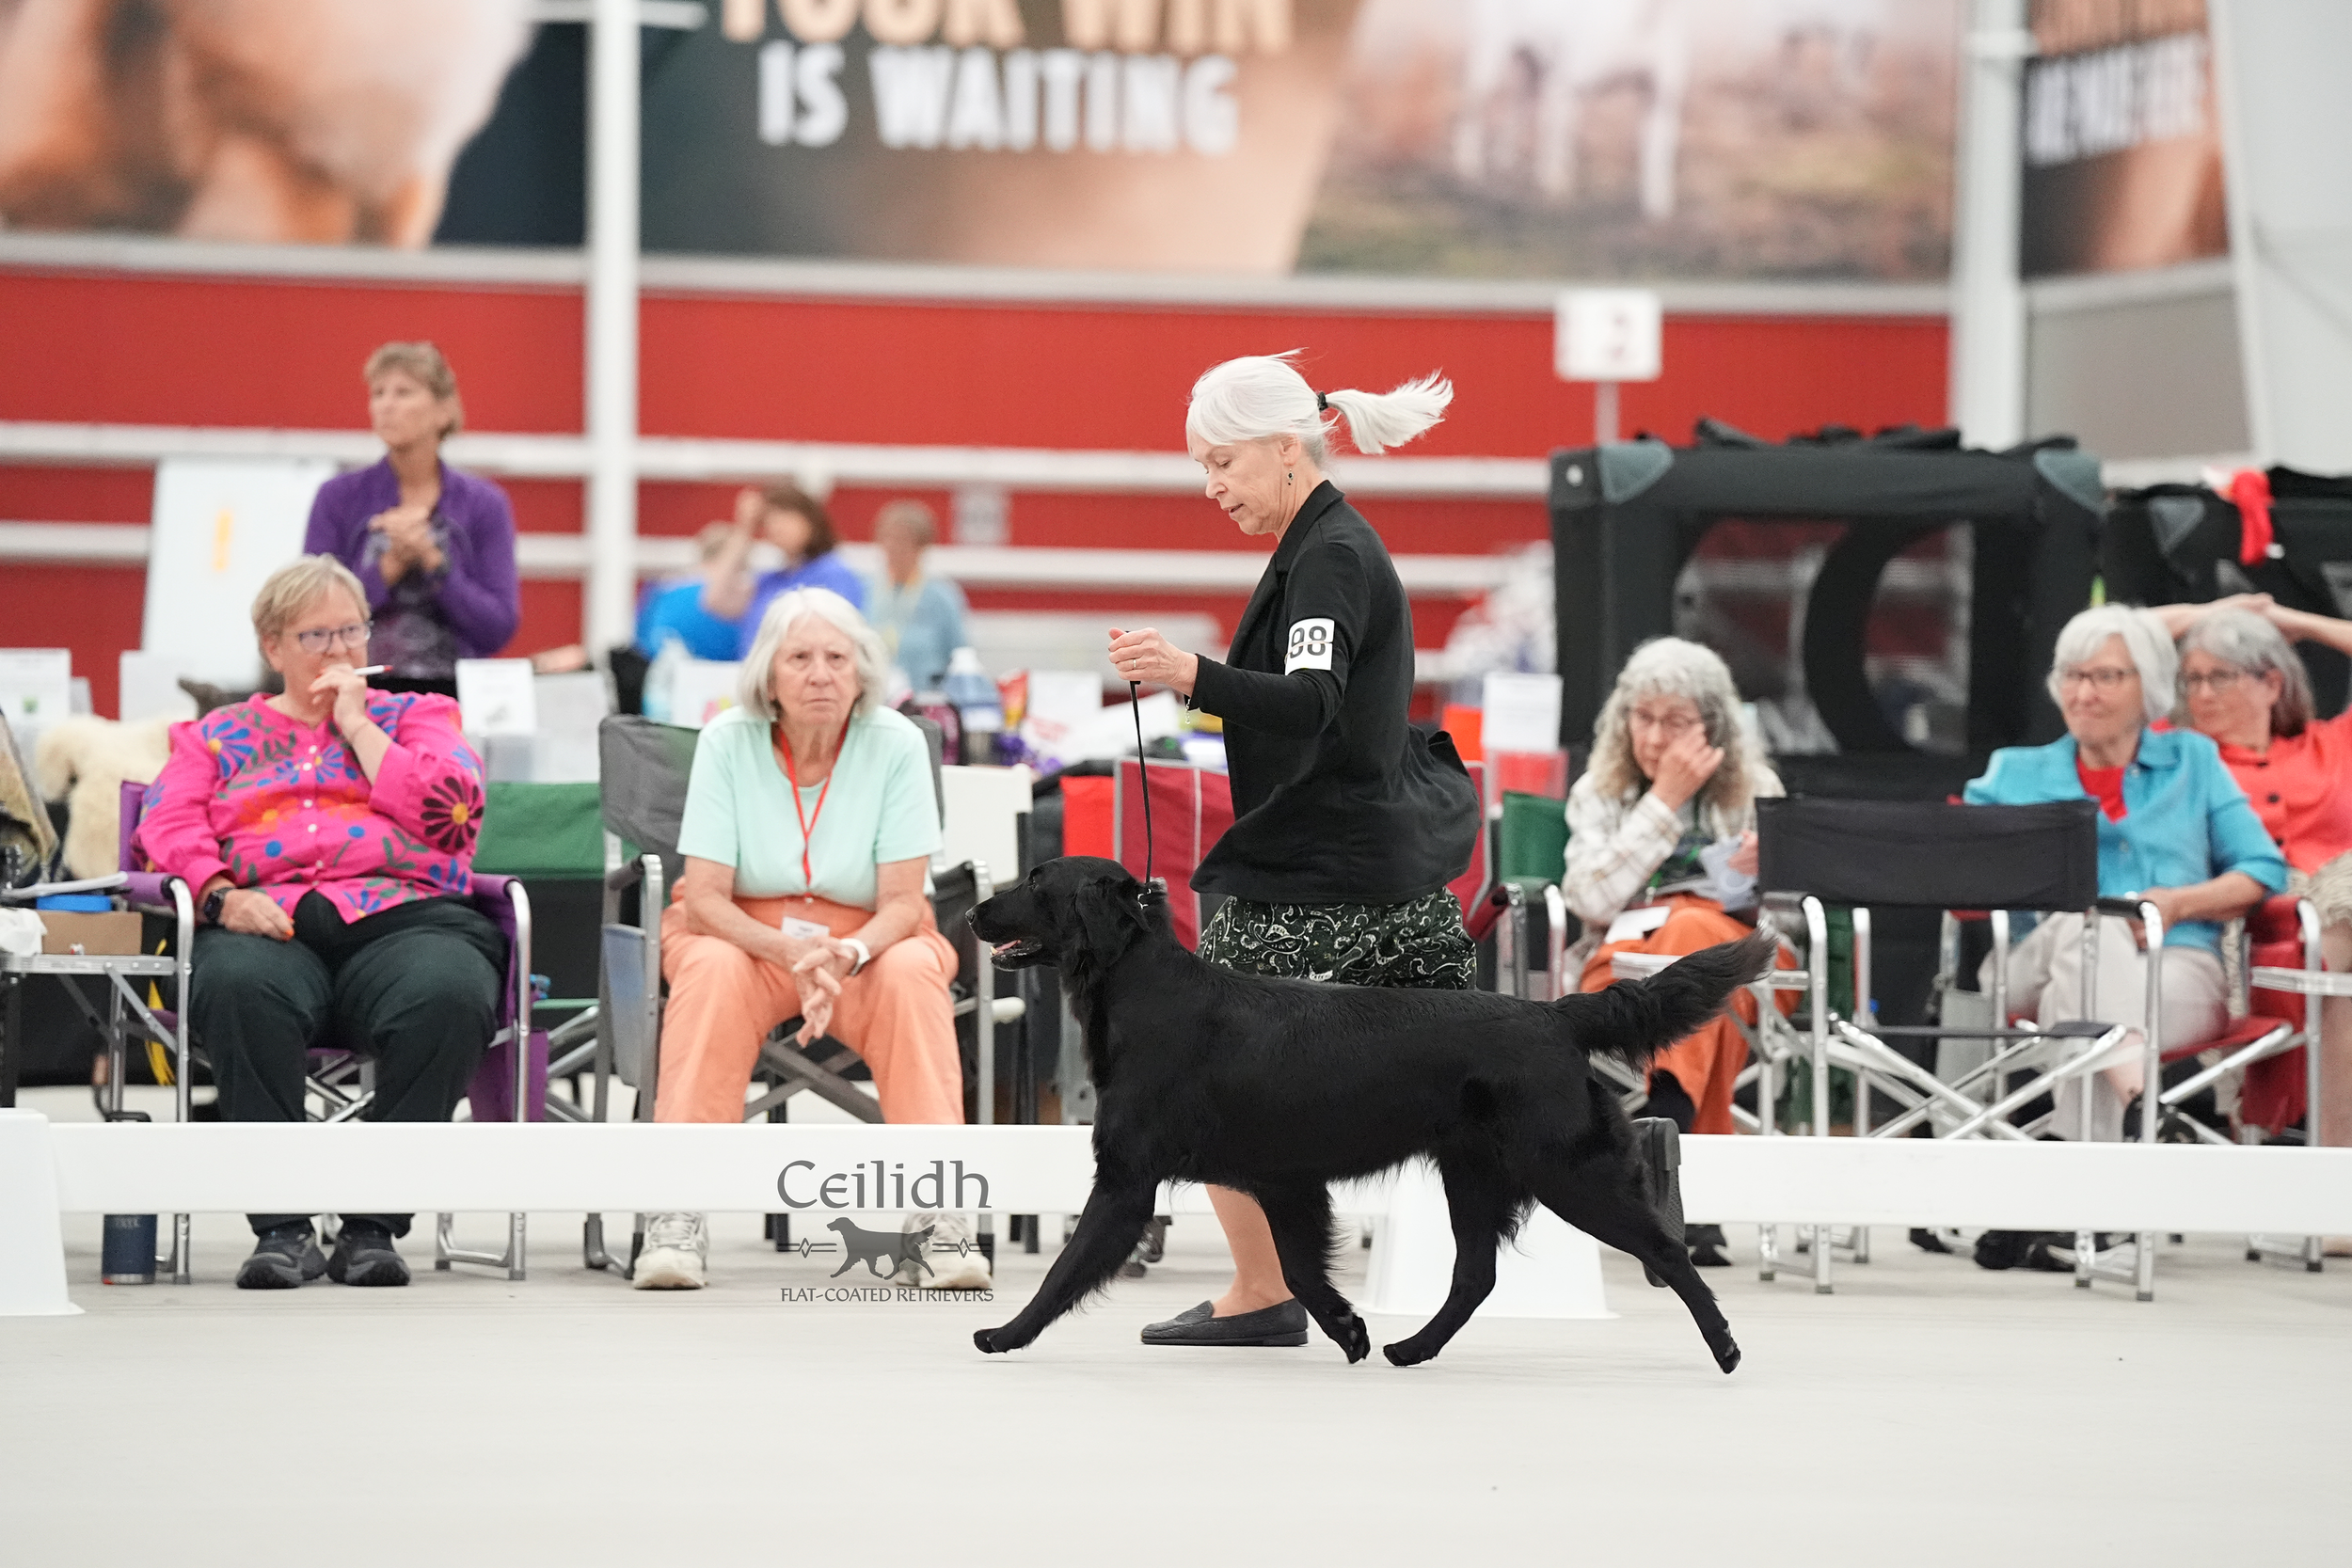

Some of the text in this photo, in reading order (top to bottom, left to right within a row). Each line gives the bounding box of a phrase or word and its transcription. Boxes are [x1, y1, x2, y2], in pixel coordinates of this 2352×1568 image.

[758, 41, 1238, 154] IS WAITING
[1290, 626, 1327, 658] 98
